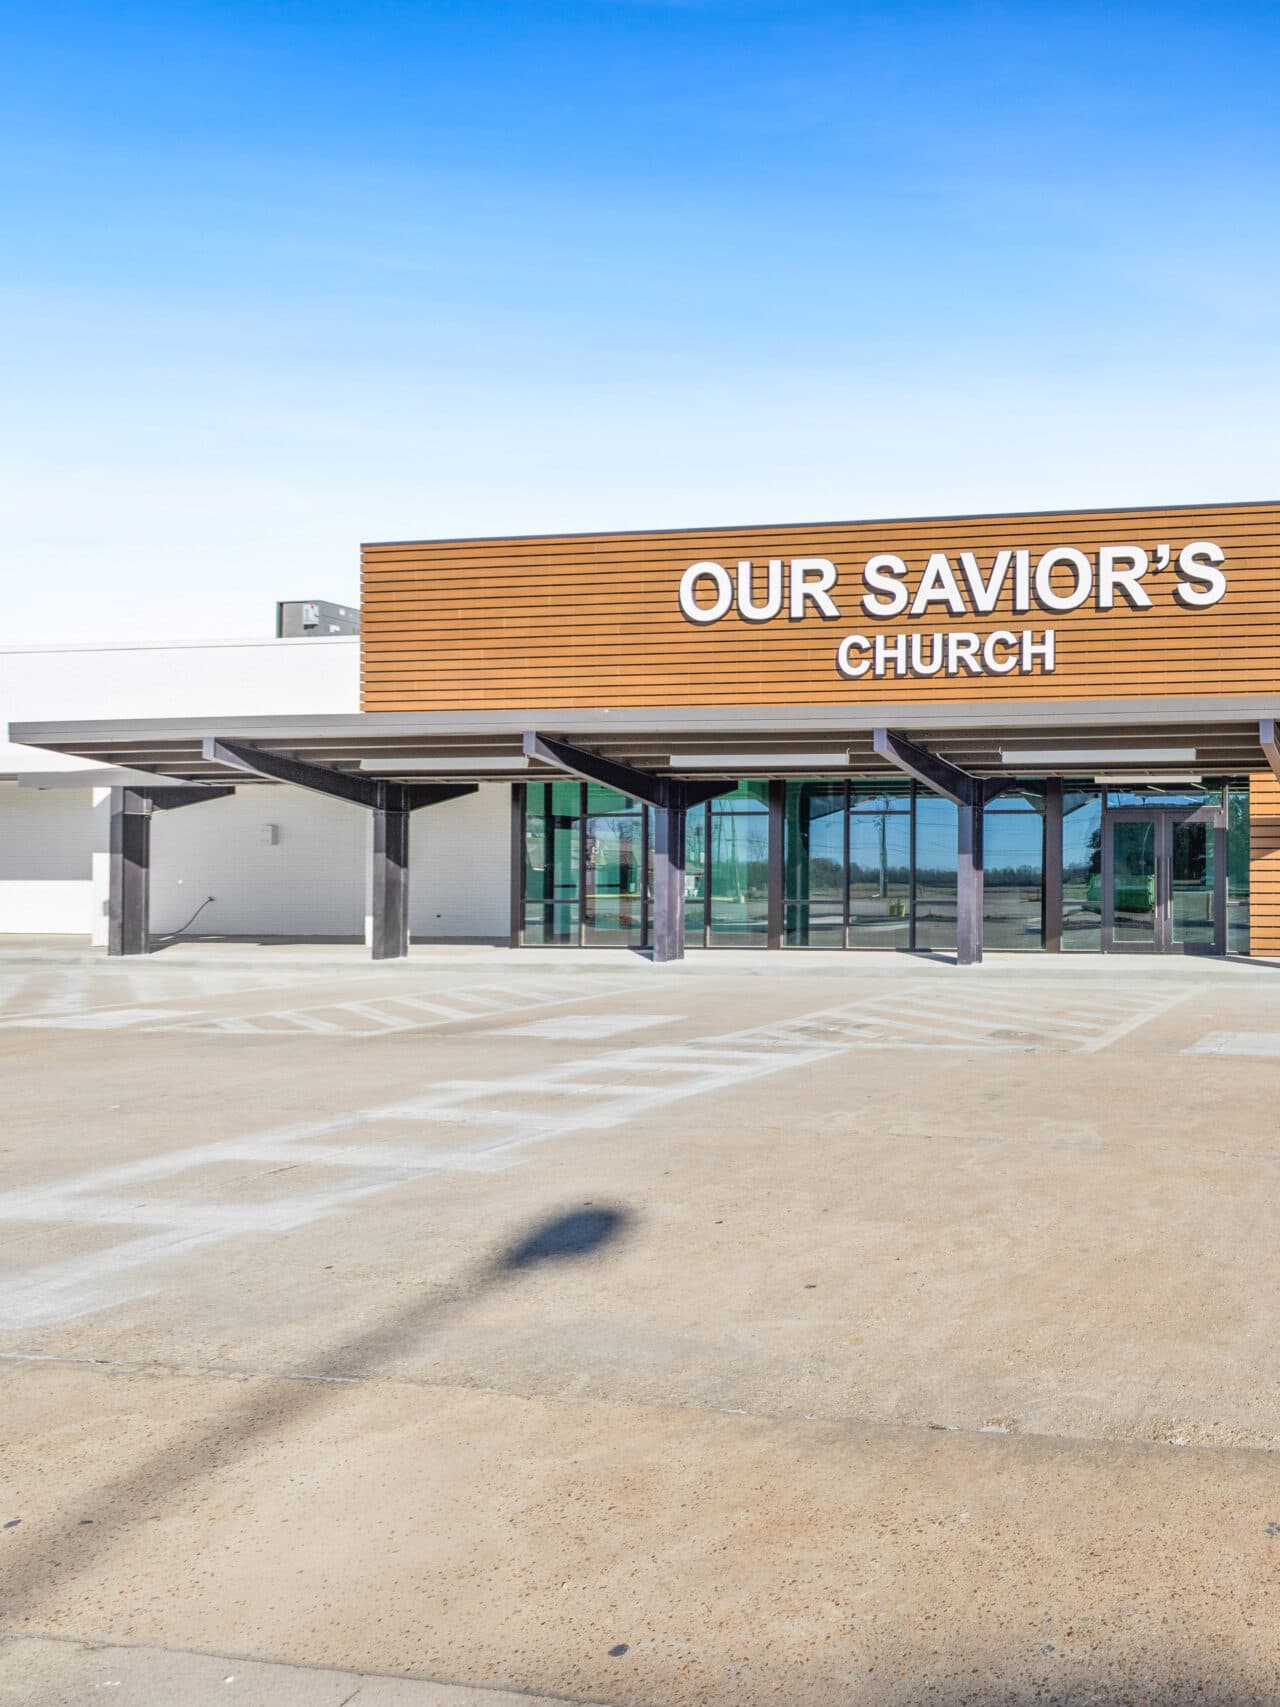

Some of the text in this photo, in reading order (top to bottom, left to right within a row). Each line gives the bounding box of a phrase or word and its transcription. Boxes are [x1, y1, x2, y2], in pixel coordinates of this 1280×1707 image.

[679, 541, 1227, 622] OUR SAVIOR’S
[837, 630, 1055, 677] CHURCH
